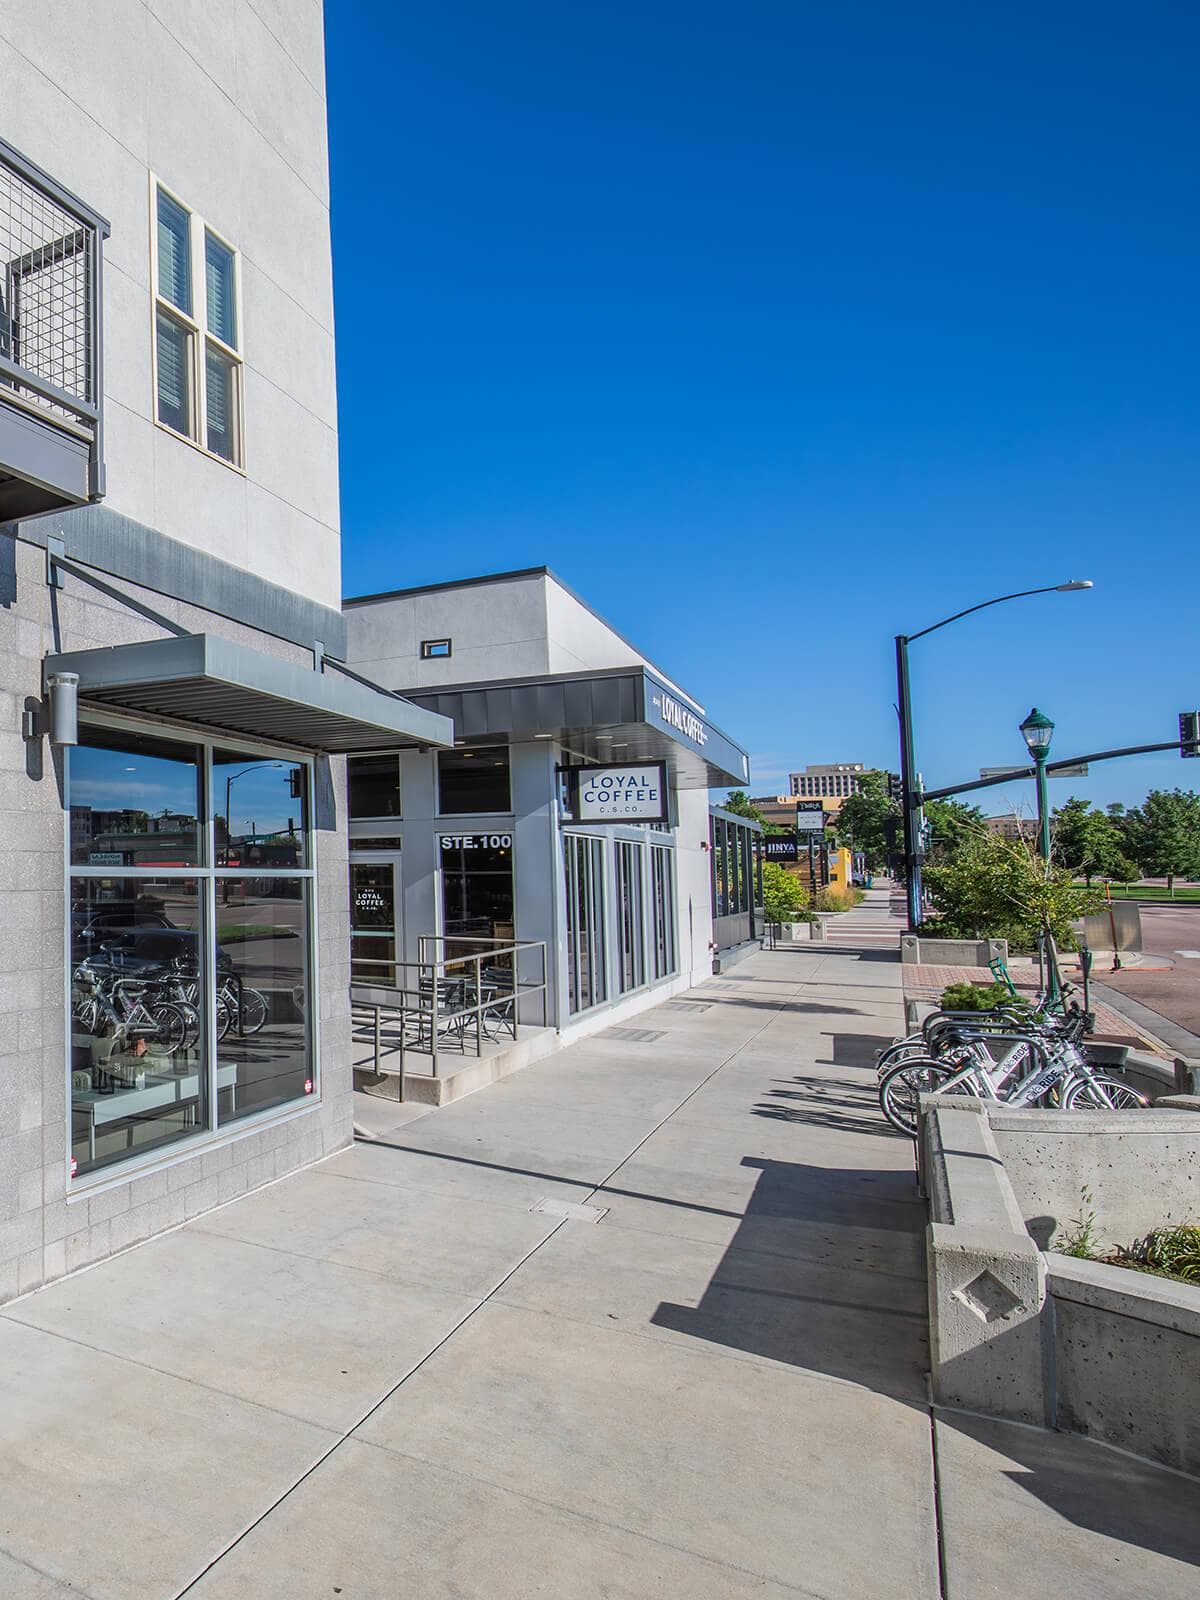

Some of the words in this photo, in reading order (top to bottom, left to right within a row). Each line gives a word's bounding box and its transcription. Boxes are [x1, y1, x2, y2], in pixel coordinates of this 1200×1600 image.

[662, 694, 682, 731] LOYAL
[591, 775, 649, 788] LOYAL
[584, 789, 657, 803] COFFEE
[767, 843, 796, 854] JINYA
